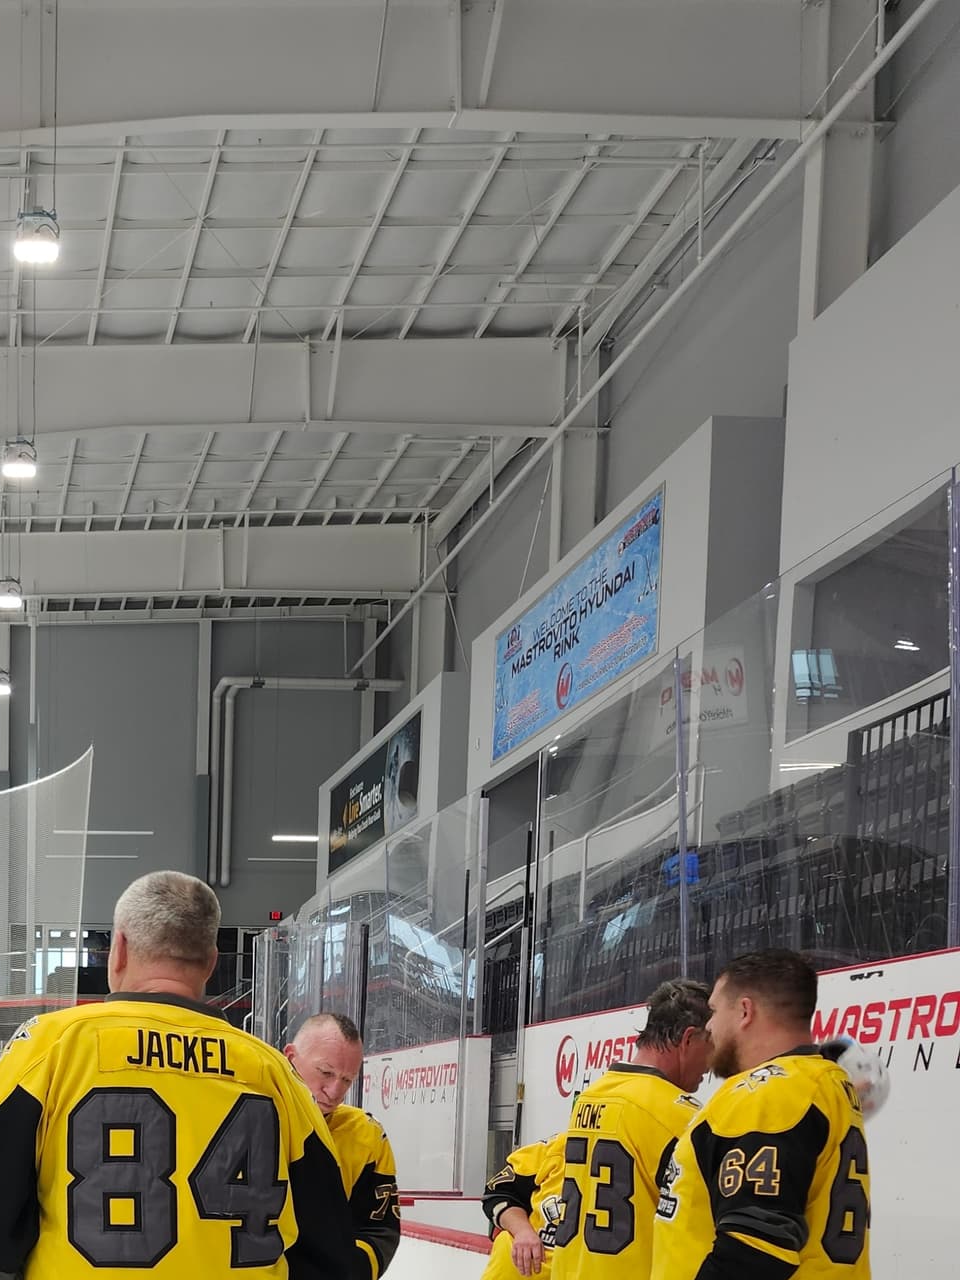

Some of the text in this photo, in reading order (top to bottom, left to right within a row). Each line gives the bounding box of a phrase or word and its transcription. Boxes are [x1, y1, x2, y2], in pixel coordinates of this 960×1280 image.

[511, 611, 578, 679] MASTROVITO
[579, 561, 636, 622] HYUNDAI
[532, 568, 608, 639] WELCOME TO THE
[553, 626, 581, 662] RINK
[126, 1029, 236, 1077] JACKEL
[396, 1063, 458, 1090] MASTROVITO
[394, 1088, 456, 1105] HYUNDAI
[574, 1103, 606, 1130] HOWE
[66, 1086, 290, 1269] 84
[554, 1136, 636, 1256] 53
[718, 1145, 781, 1198] 64
[821, 1125, 871, 1265] 6
